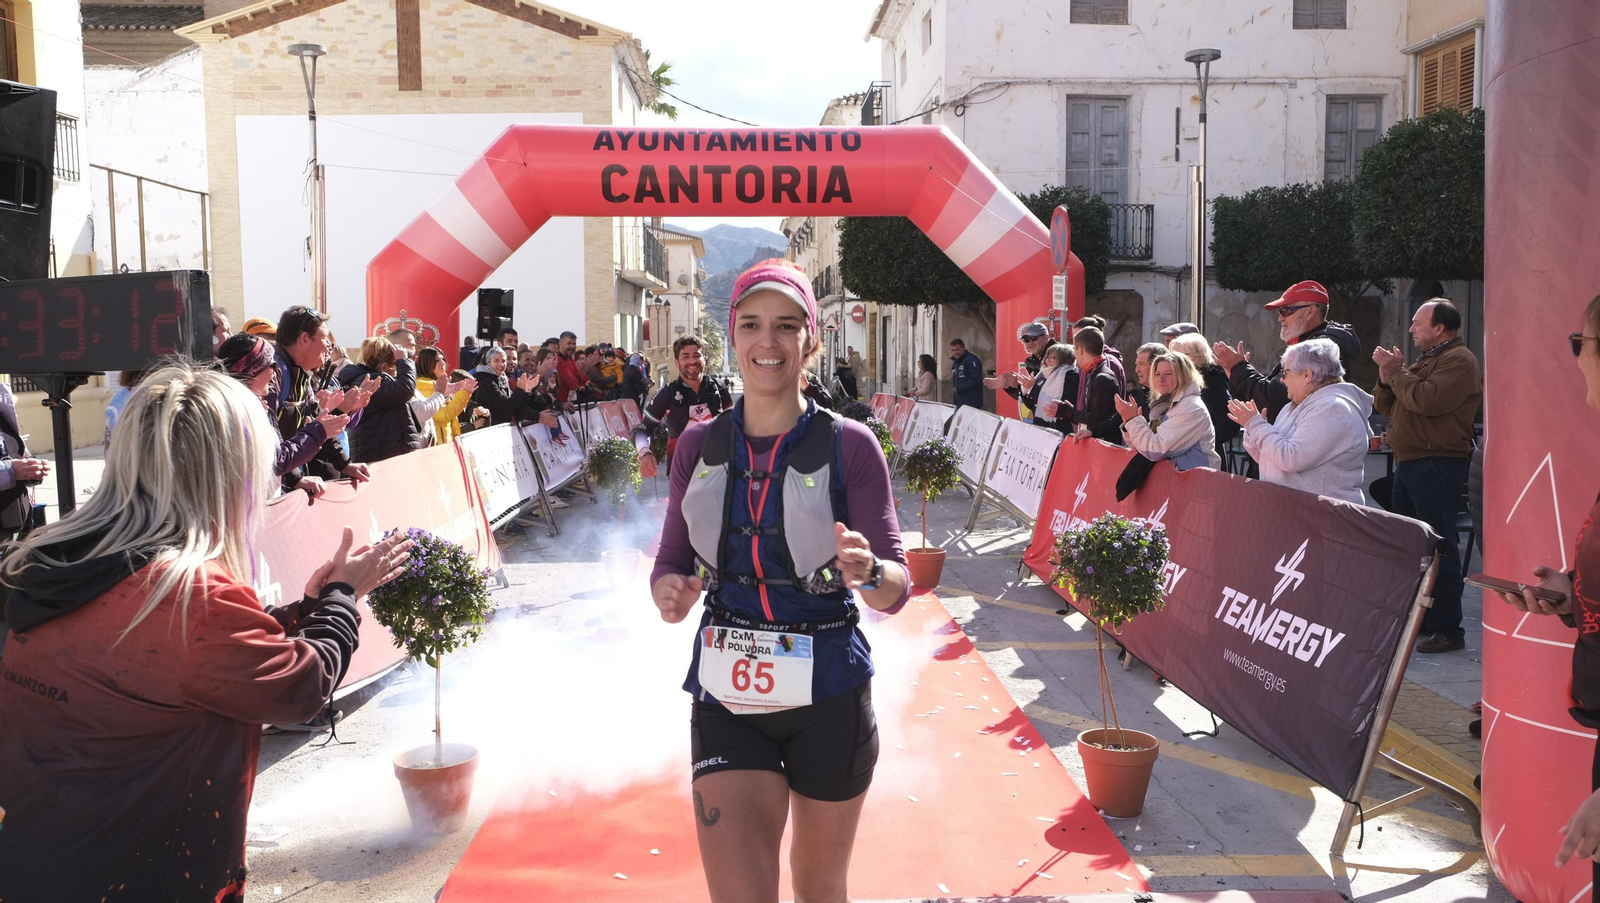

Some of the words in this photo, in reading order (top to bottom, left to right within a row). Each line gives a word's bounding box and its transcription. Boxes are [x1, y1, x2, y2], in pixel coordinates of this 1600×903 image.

[593, 130, 862, 152] AYUNTAMIENTO
[600, 163, 853, 204] CANTORIA
[998, 451, 1046, 494] CANTORIA
[731, 630, 755, 642] CxM
[1214, 586, 1346, 668] TEAMERGY
[728, 640, 772, 656] PÓLVORA
[731, 658, 775, 695] 65
[1223, 648, 1287, 693] www.teamergy.es
